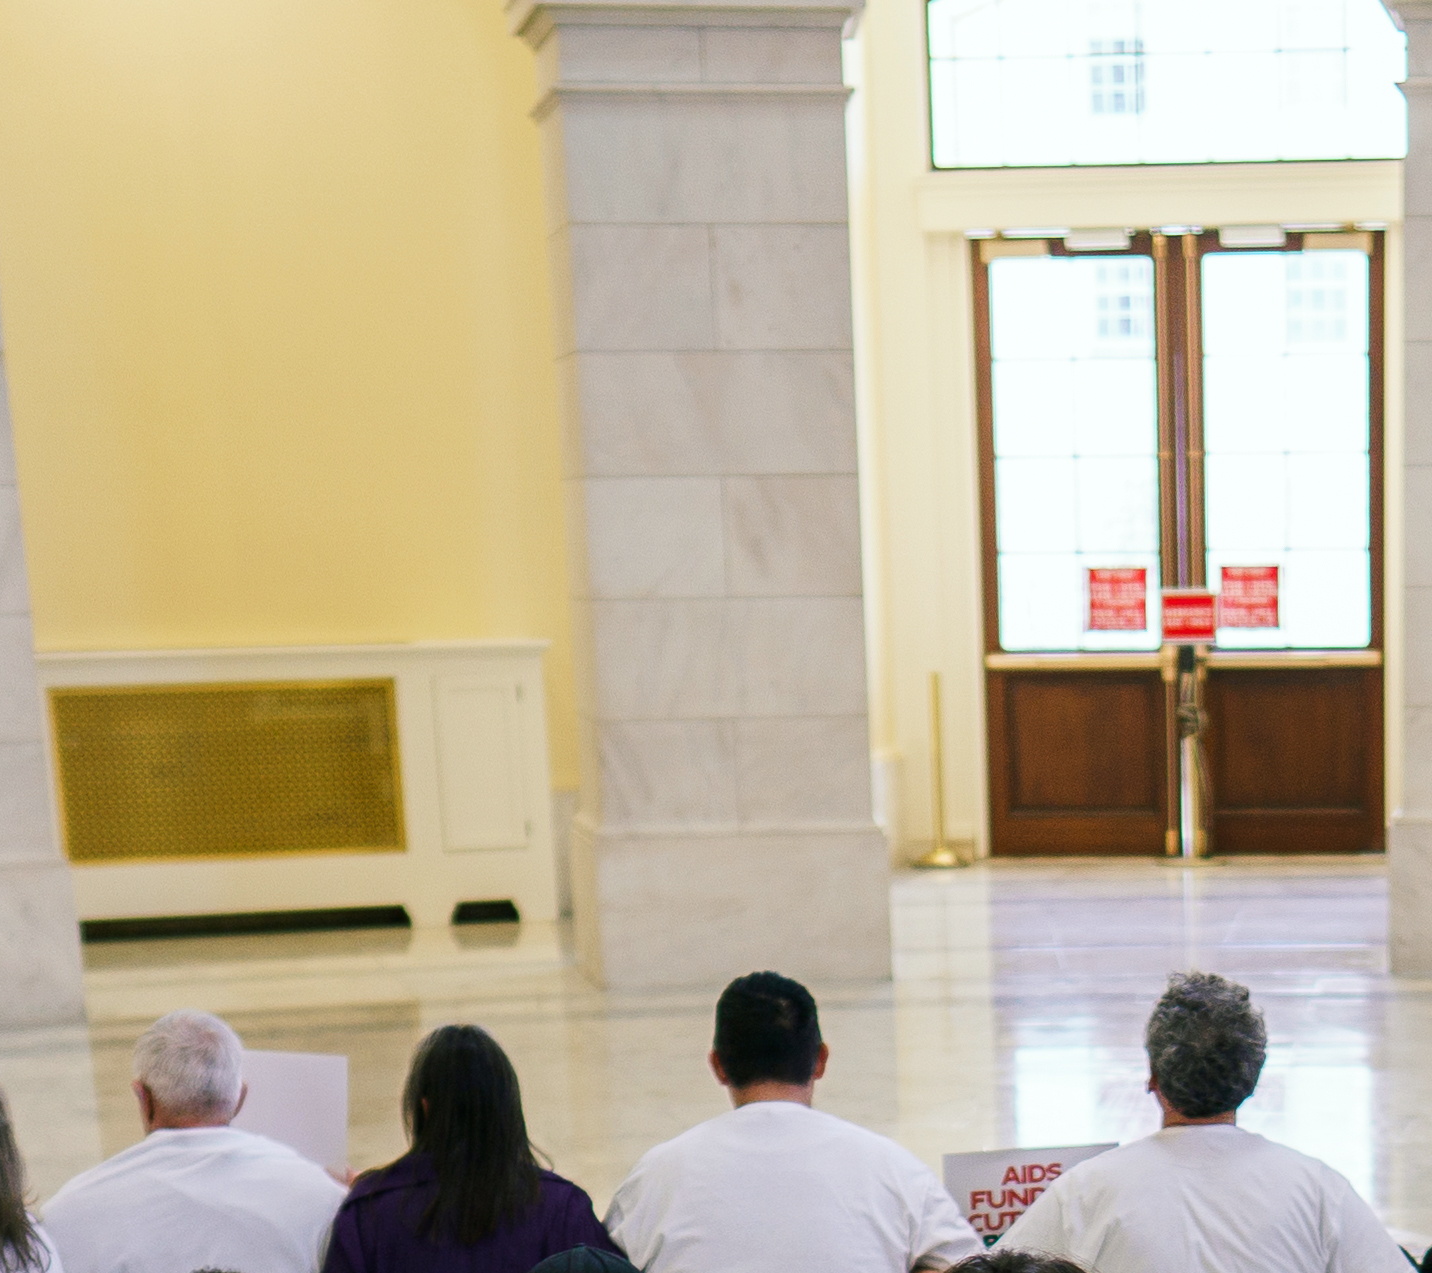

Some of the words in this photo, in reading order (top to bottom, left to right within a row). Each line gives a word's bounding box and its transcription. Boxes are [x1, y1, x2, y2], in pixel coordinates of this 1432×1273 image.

[1001, 1162, 1063, 1186] AIDS
[969, 1187, 1047, 1210] FUND
[968, 1210, 1025, 1231] CUT
